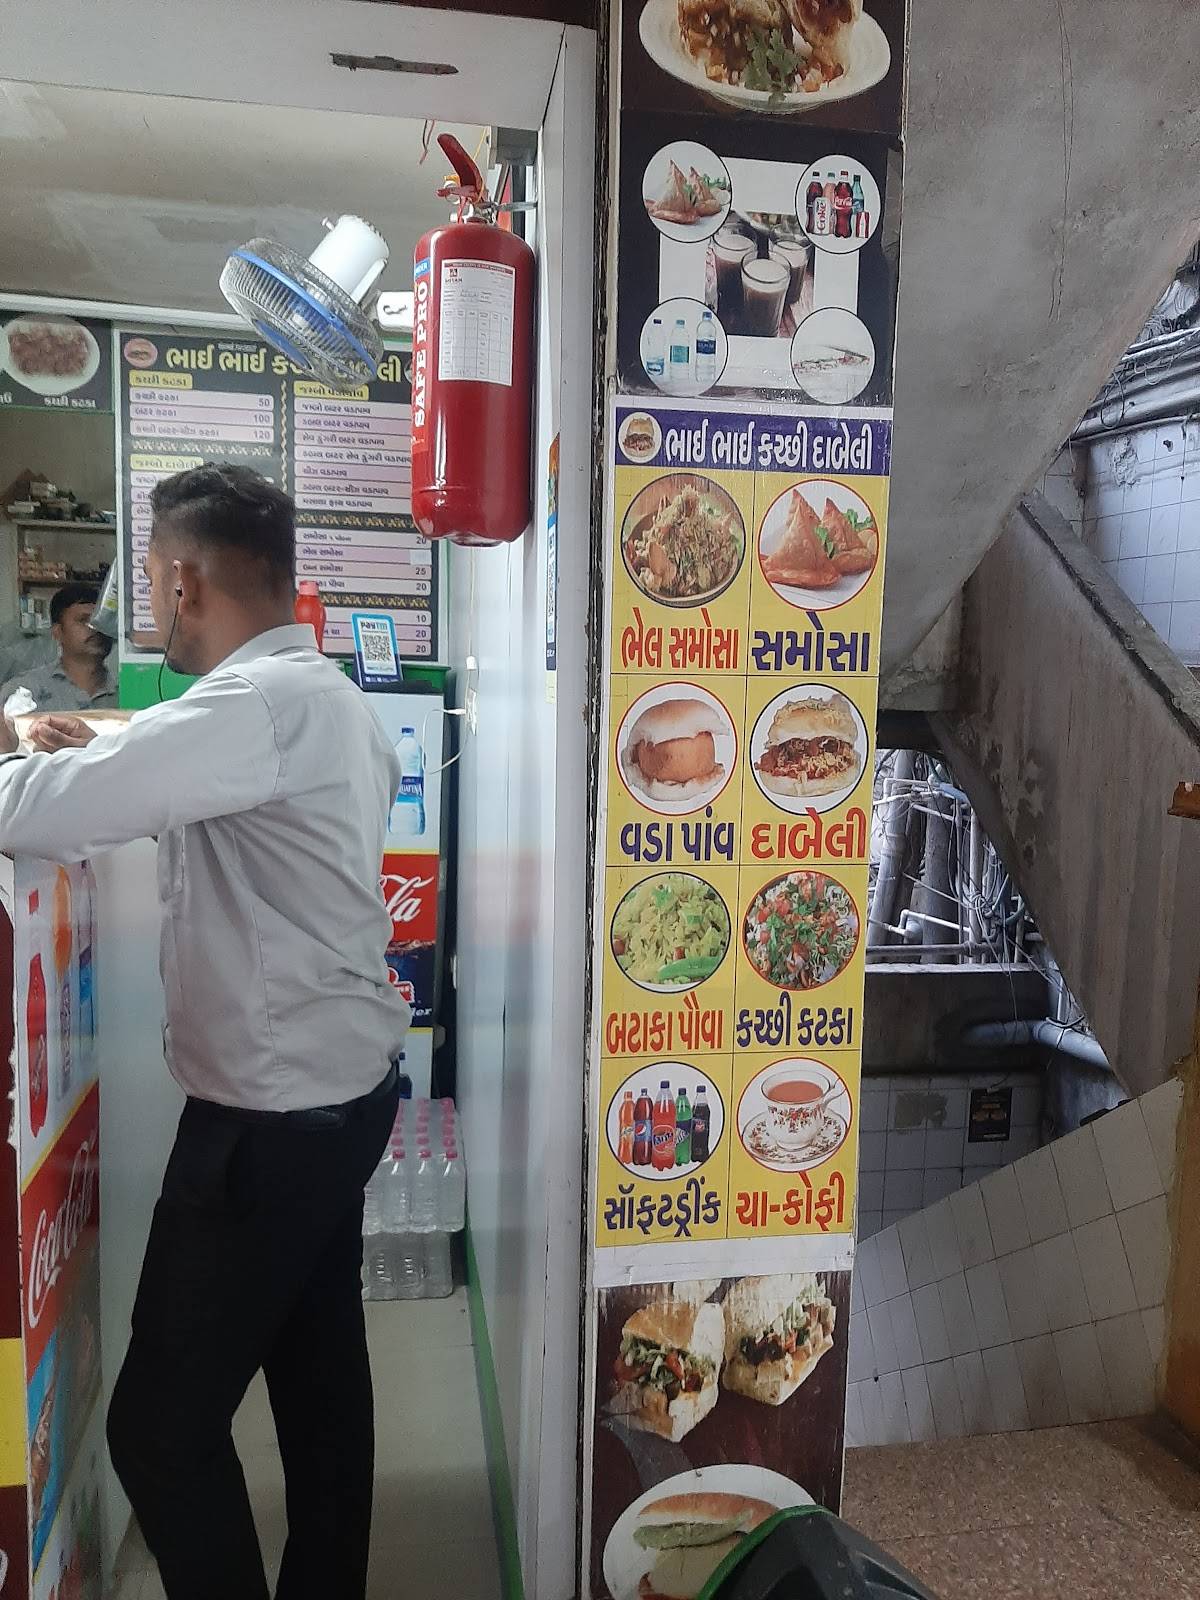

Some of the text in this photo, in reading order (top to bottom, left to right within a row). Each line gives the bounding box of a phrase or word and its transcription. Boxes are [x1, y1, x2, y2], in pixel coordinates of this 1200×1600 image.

[416, 281, 428, 344] PRO
[259, 398, 270, 407] 50
[414, 349, 427, 428] SAFE
[253, 414, 270, 423] 100
[253, 430, 270, 439] 120
[758, 420, 807, 468] કચ્છી
[812, 422, 873, 470] દાબેલી
[415, 567, 427, 576] 25
[416, 582, 427, 591] 20
[415, 629, 427, 638] 20
[416, 614, 427, 623] 10
[621, 606, 739, 669] ભેલ સમોસા
[751, 611, 871, 672] સમોસા
[415, 644, 427, 653] 20
[620, 805, 735, 863] વડા પાંવ
[750, 806, 867, 860] દાબેલી
[605, 991, 724, 1055] બટાકા પૌવા
[735, 990, 854, 1048] કચ્છી કટકા
[735, 1171, 845, 1232] ચા-કોફી
